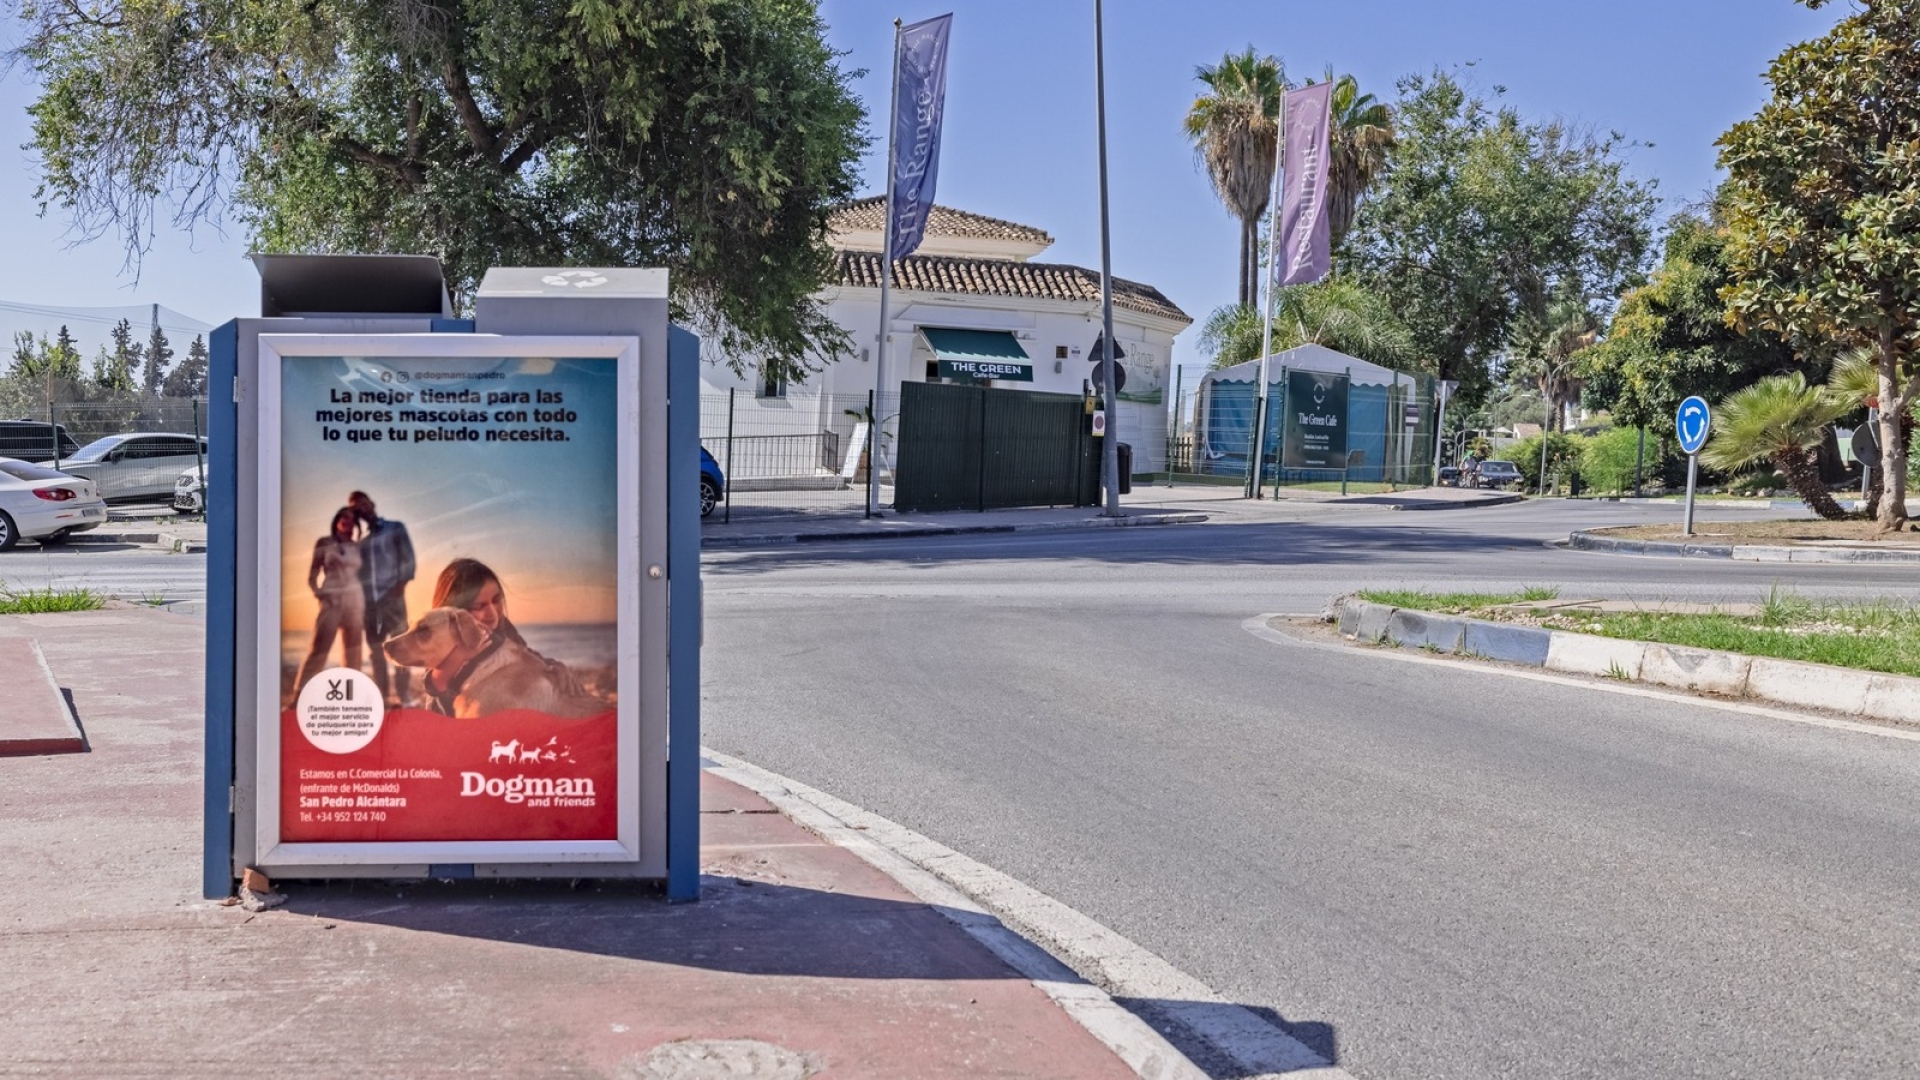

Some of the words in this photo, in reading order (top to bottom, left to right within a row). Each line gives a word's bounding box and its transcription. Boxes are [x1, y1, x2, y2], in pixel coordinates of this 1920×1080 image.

[904, 88, 936, 182] Range
[1291, 142, 1319, 270] Restaurant
[899, 185, 921, 244] The
[951, 362, 977, 372] THE
[979, 364, 1022, 374] GREEN
[414, 371, 506, 381] @dogmansanpedro
[330, 389, 351, 403] La
[358, 388, 415, 406] mejor
[420, 388, 481, 404] tienda
[487, 391, 530, 406] para
[536, 388, 563, 404] las
[316, 407, 393, 424] mejores
[400, 409, 488, 423] mascotas
[494, 410, 528, 423] con
[533, 408, 578, 423] todo
[1298, 412, 1309, 425] The
[1309, 413, 1325, 426] Green
[323, 426, 341, 441] lo
[346, 429, 382, 443] que
[388, 428, 408, 441] tu
[414, 426, 480, 443] peludo
[486, 426, 571, 441] necesita.
[300, 769, 335, 779] Estamos
[336, 771, 348, 779] en
[398, 769, 408, 779] La
[409, 768, 443, 779] Colonia.
[340, 784, 351, 793] de
[352, 783, 400, 794] McDonalds)
[460, 771, 596, 803] Dogman
[300, 796, 319, 807] San
[321, 797, 354, 807] Pedro
[356, 796, 407, 807] Alcántara
[527, 797, 550, 807] and
[554, 797, 596, 807] friends
[300, 812, 314, 821] Tel.
[316, 812, 332, 821] +34
[334, 812, 351, 821] 952
[353, 812, 368, 821] 124
[370, 812, 386, 821] 740
